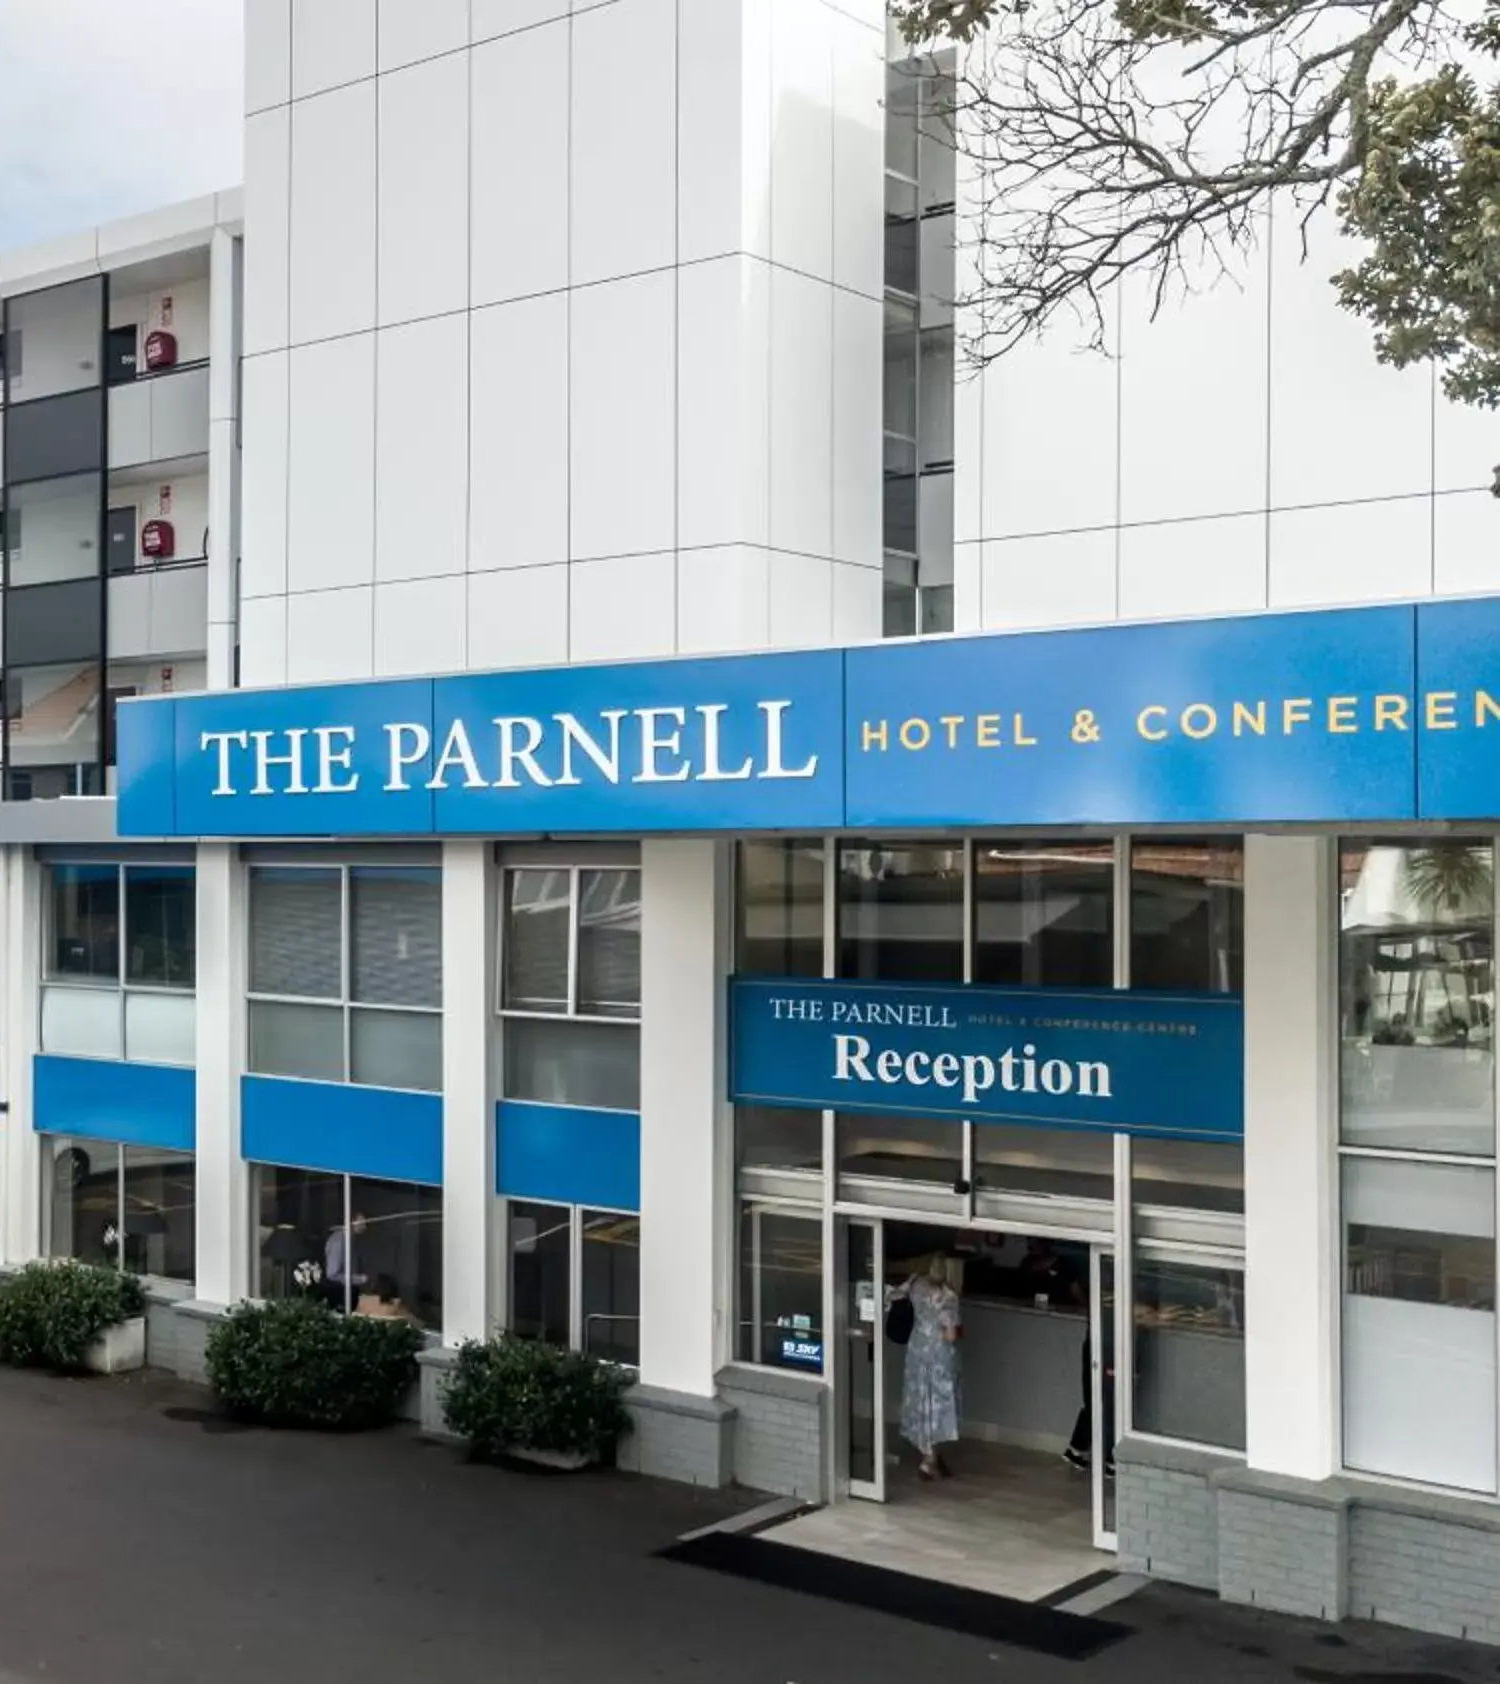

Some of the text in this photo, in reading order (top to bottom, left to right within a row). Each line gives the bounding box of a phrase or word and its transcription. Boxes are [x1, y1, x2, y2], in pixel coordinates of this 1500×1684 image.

[200, 690, 1500, 796] THE PARNELL HOTEL & CONFEREN
[769, 998, 824, 1021] THE
[831, 1001, 958, 1028] PARNELL
[831, 1034, 1114, 1103] Reception
